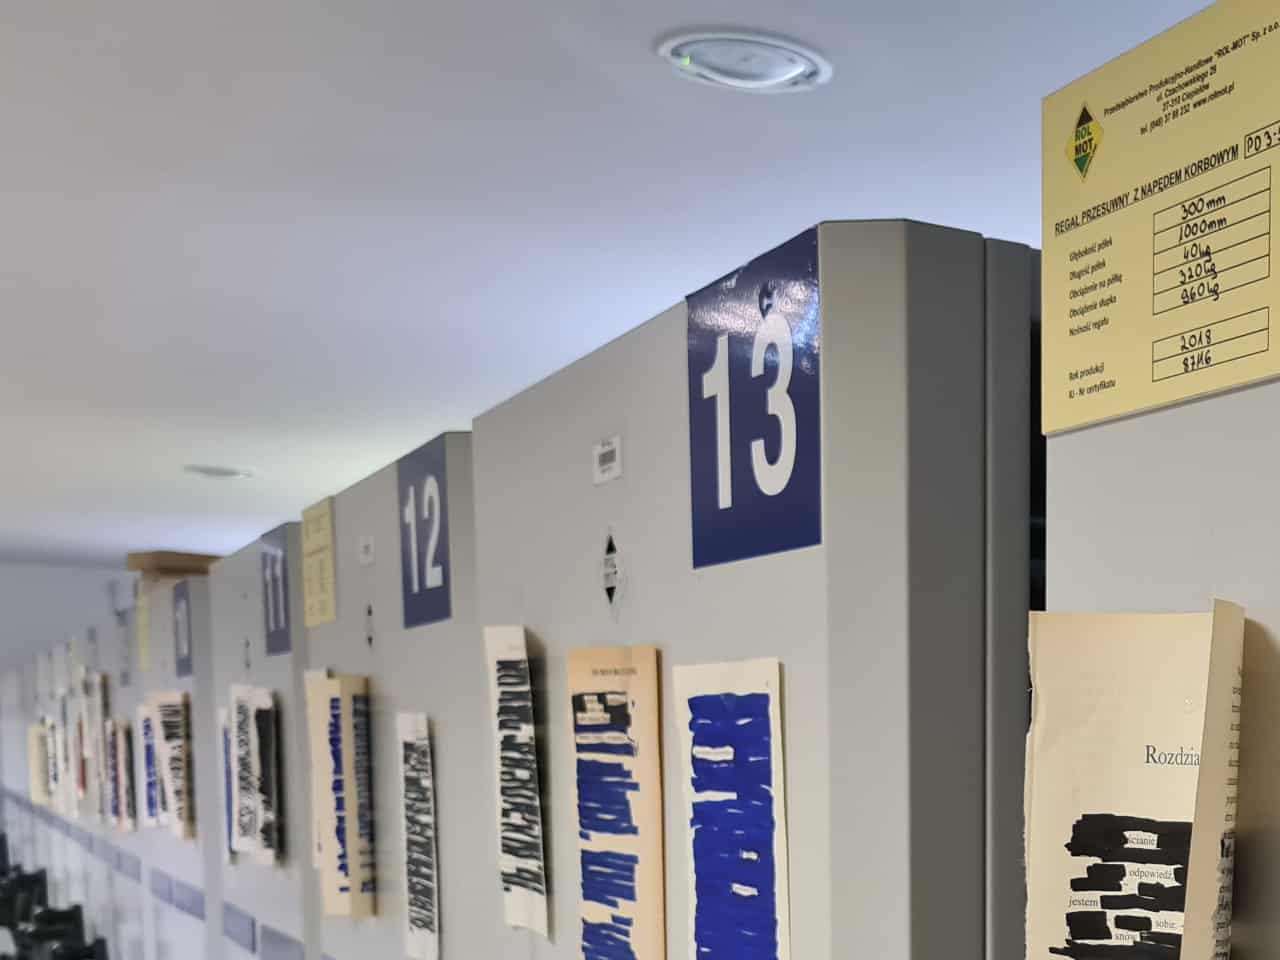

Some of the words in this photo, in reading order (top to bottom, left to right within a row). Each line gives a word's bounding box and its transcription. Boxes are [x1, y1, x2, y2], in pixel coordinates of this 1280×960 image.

[1074, 137, 1095, 159] MOT
[1081, 191, 1131, 226] PRZESUWNY
[1184, 143, 1239, 180] KORBOWYM
[702, 312, 797, 510] 13
[404, 474, 443, 594] 12
